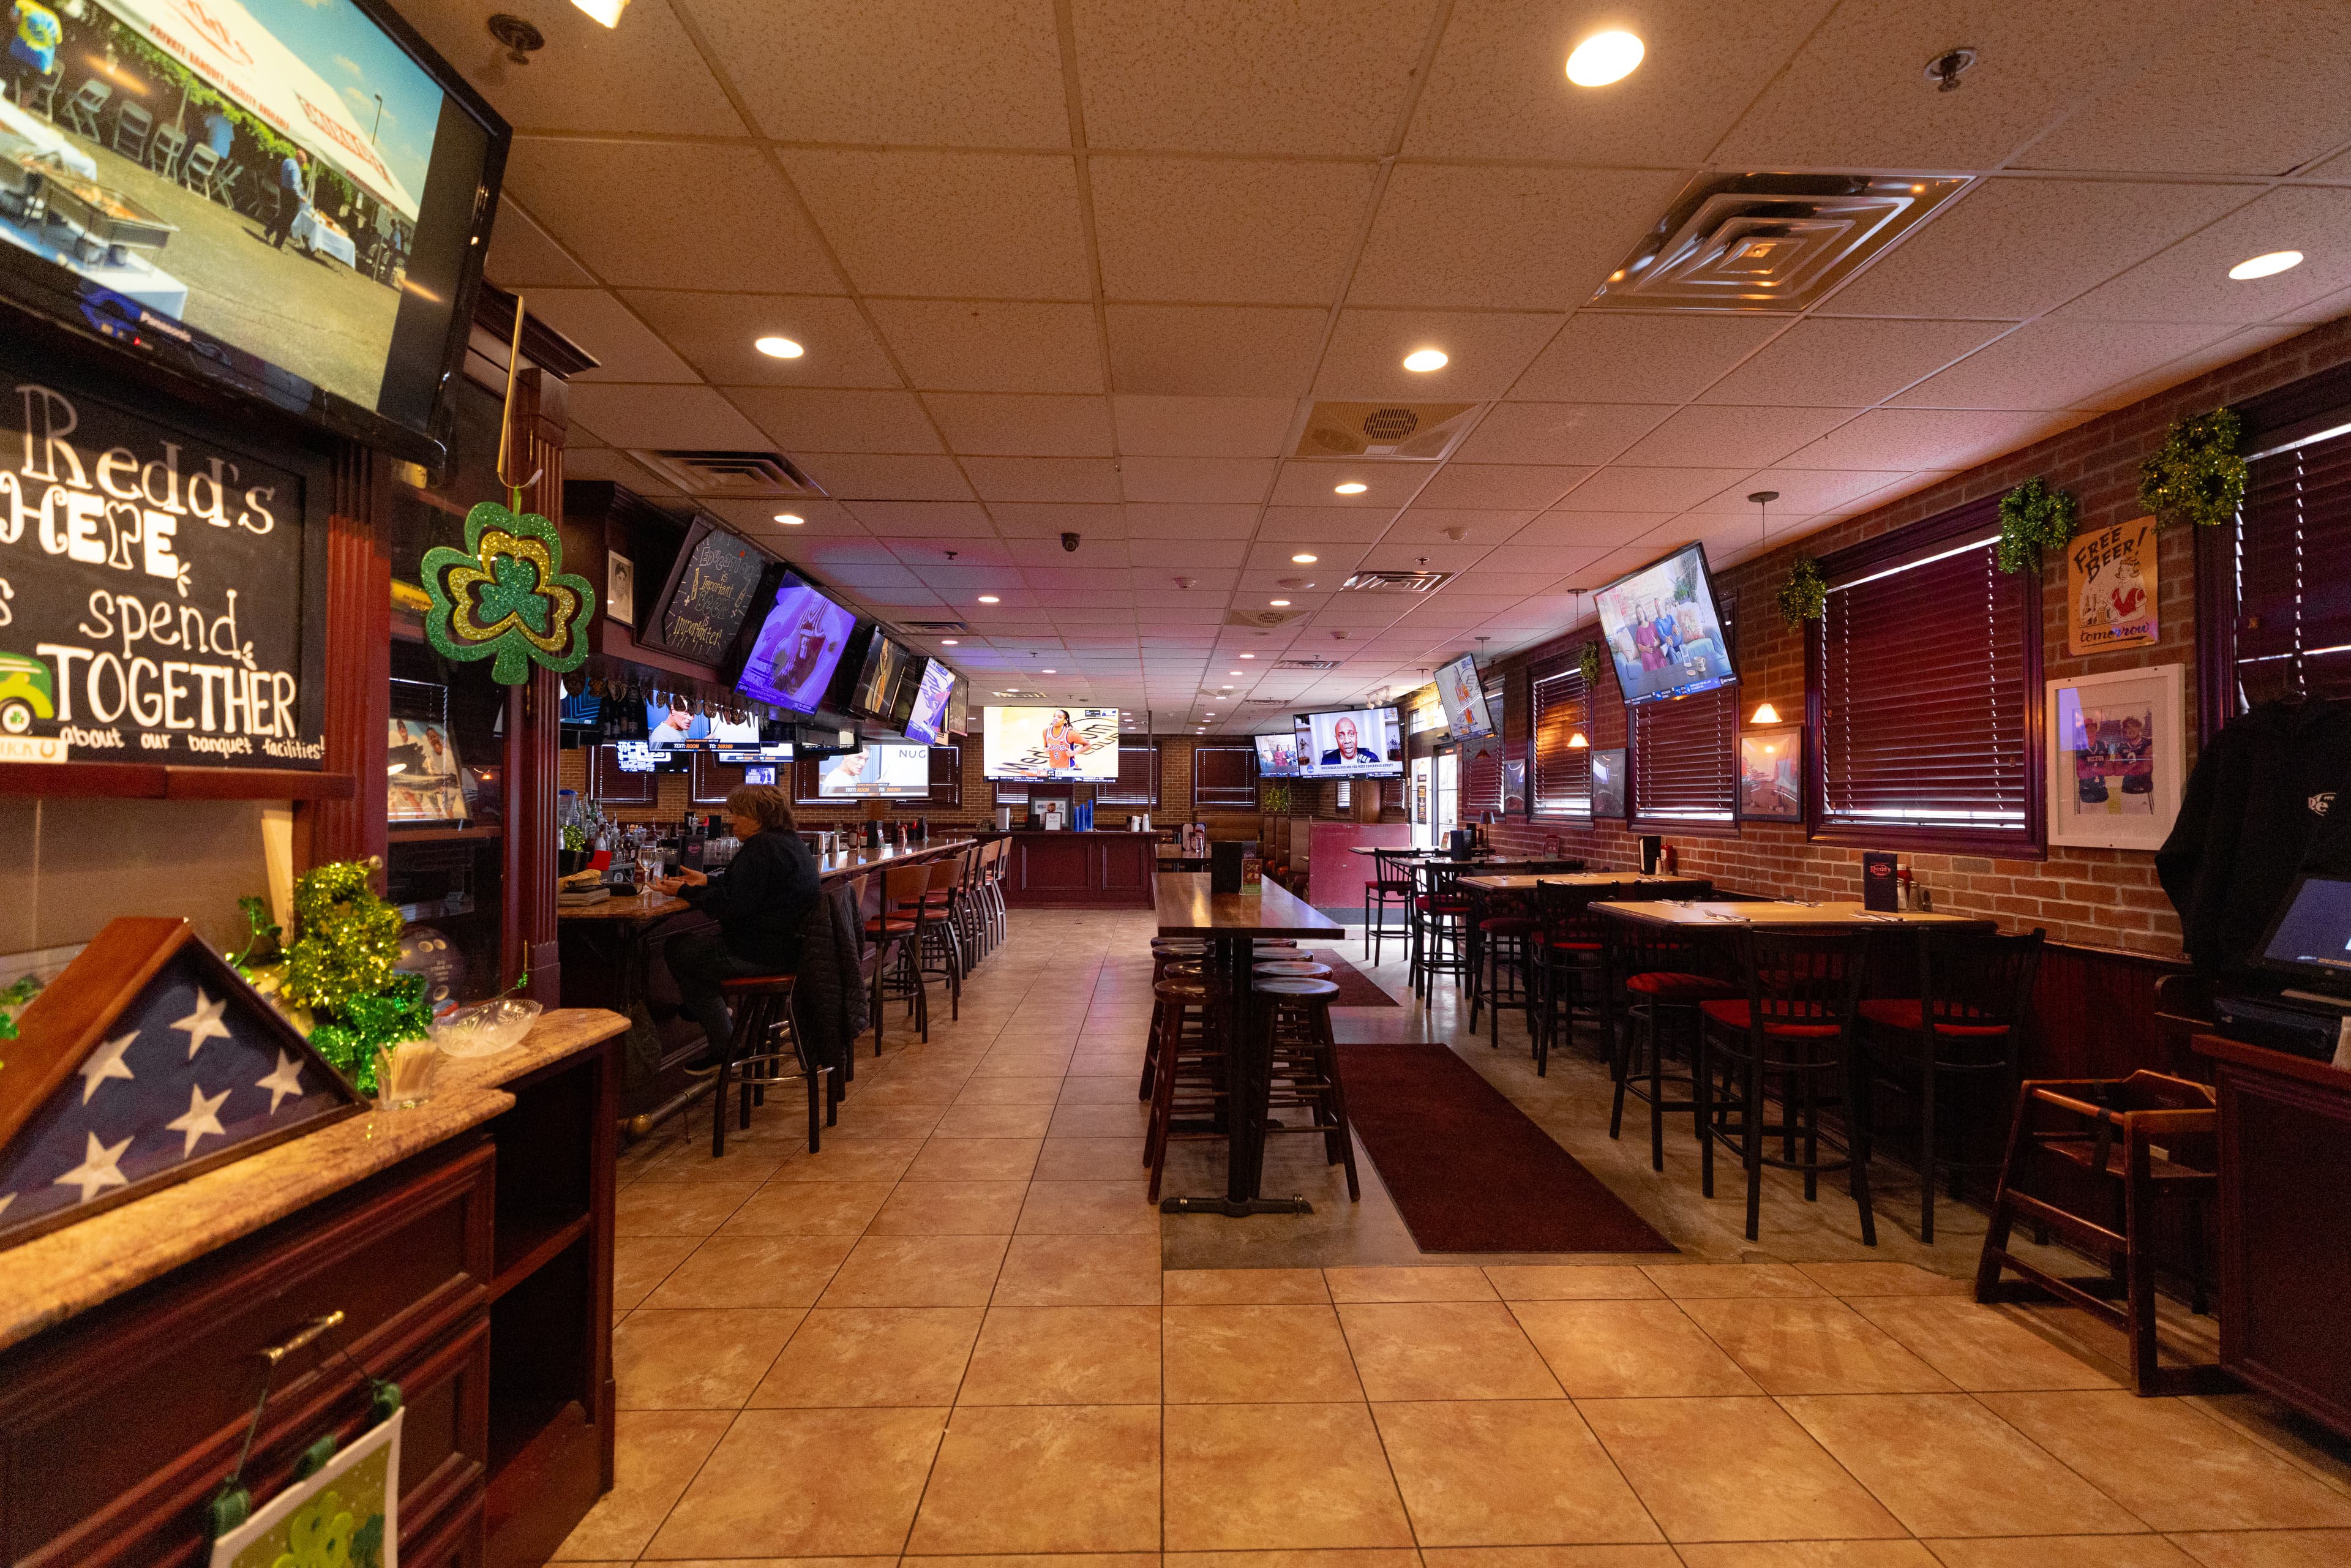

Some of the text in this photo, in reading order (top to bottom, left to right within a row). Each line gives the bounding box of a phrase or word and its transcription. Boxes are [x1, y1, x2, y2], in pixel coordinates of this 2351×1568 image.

[15, 384, 276, 535] Redd's
[2074, 527, 2123, 574] FREE
[2085, 527, 2148, 585] BEER!
[699, 576, 734, 598] Important
[721, 571, 729, 582] is
[79, 589, 242, 659] spend
[673, 616, 723, 645] Importanter
[703, 615, 710, 626] is
[2080, 621, 2150, 642] tomorrow
[36, 642, 296, 738] TOGETHER
[60, 727, 326, 760] about our banquet facilities!
[899, 749, 926, 759] NUG
[1870, 865, 1891, 874] Redd's
